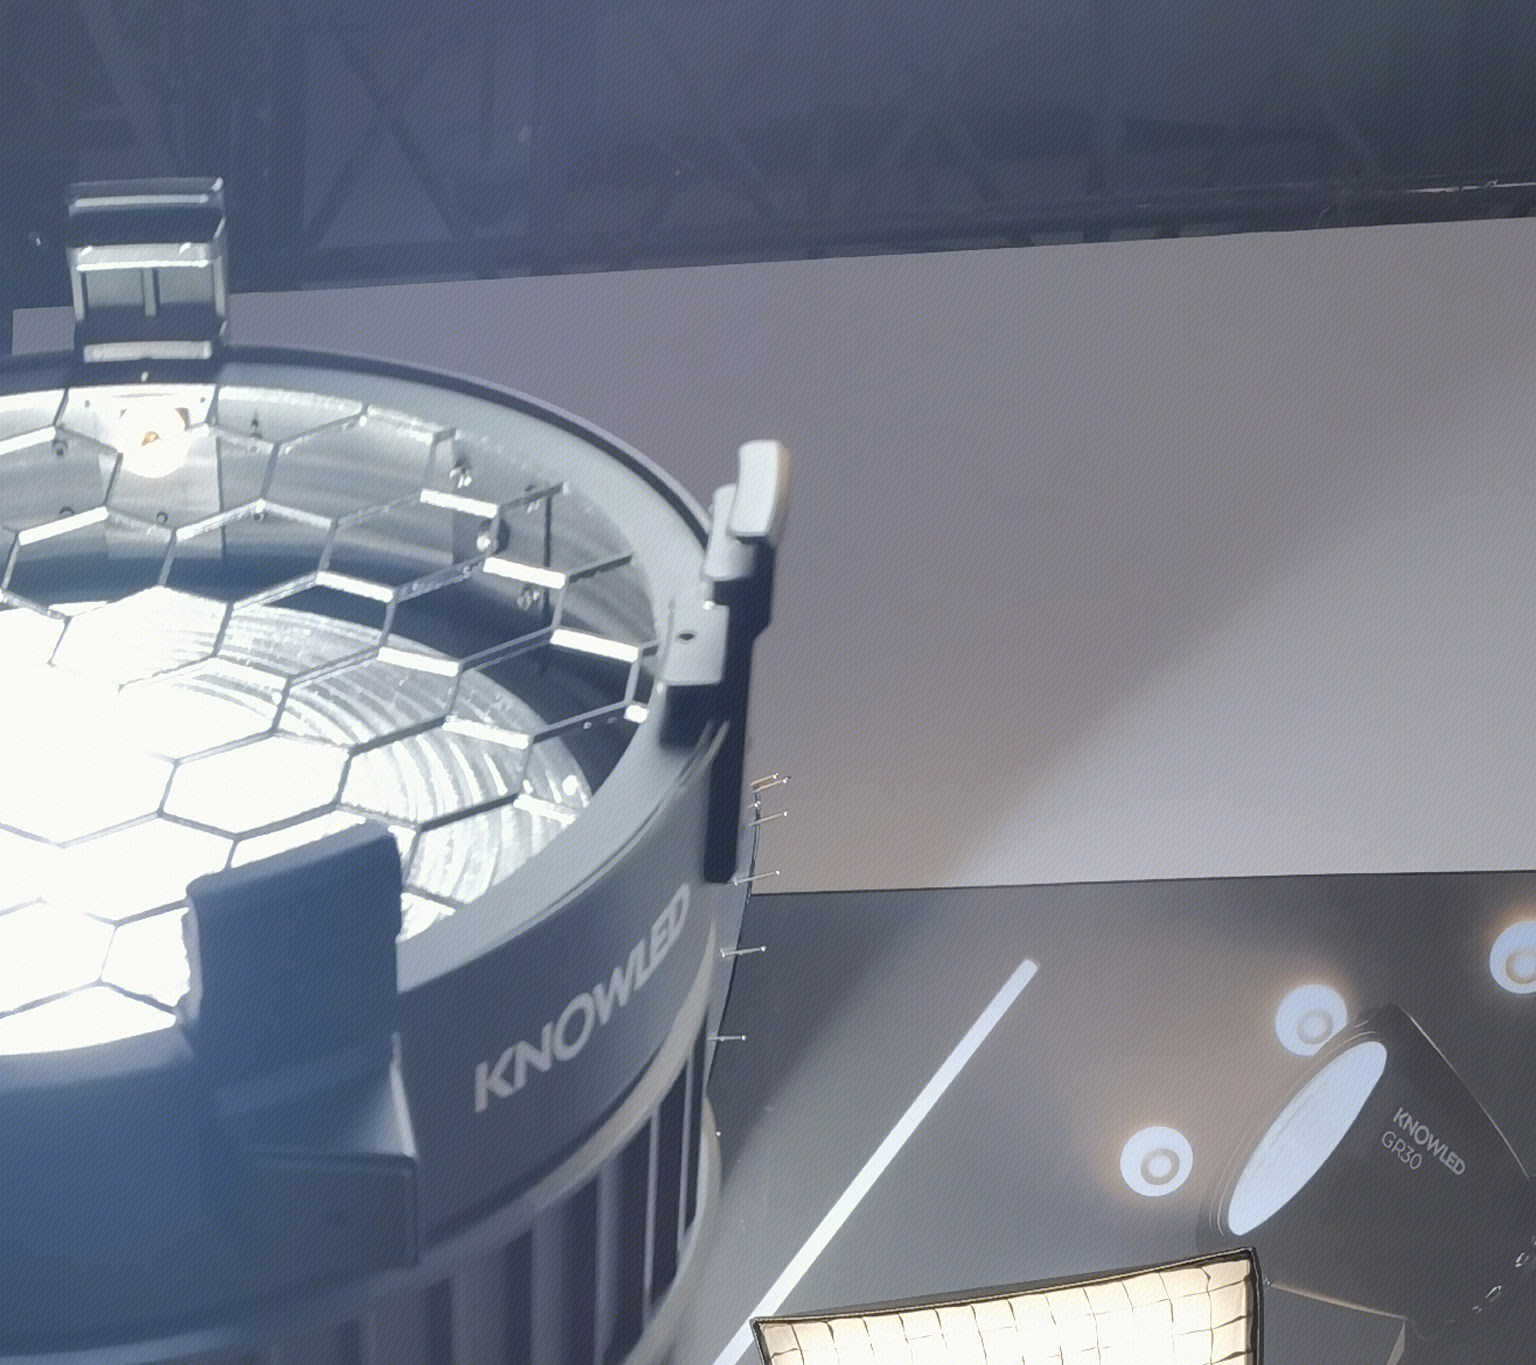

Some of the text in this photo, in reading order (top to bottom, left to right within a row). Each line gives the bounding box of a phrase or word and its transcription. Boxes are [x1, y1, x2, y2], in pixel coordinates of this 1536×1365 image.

[474, 882, 691, 1114] KNOWLED
[1381, 1130, 1423, 1170] GR30
[1392, 1106, 1466, 1176] KNOWLED
